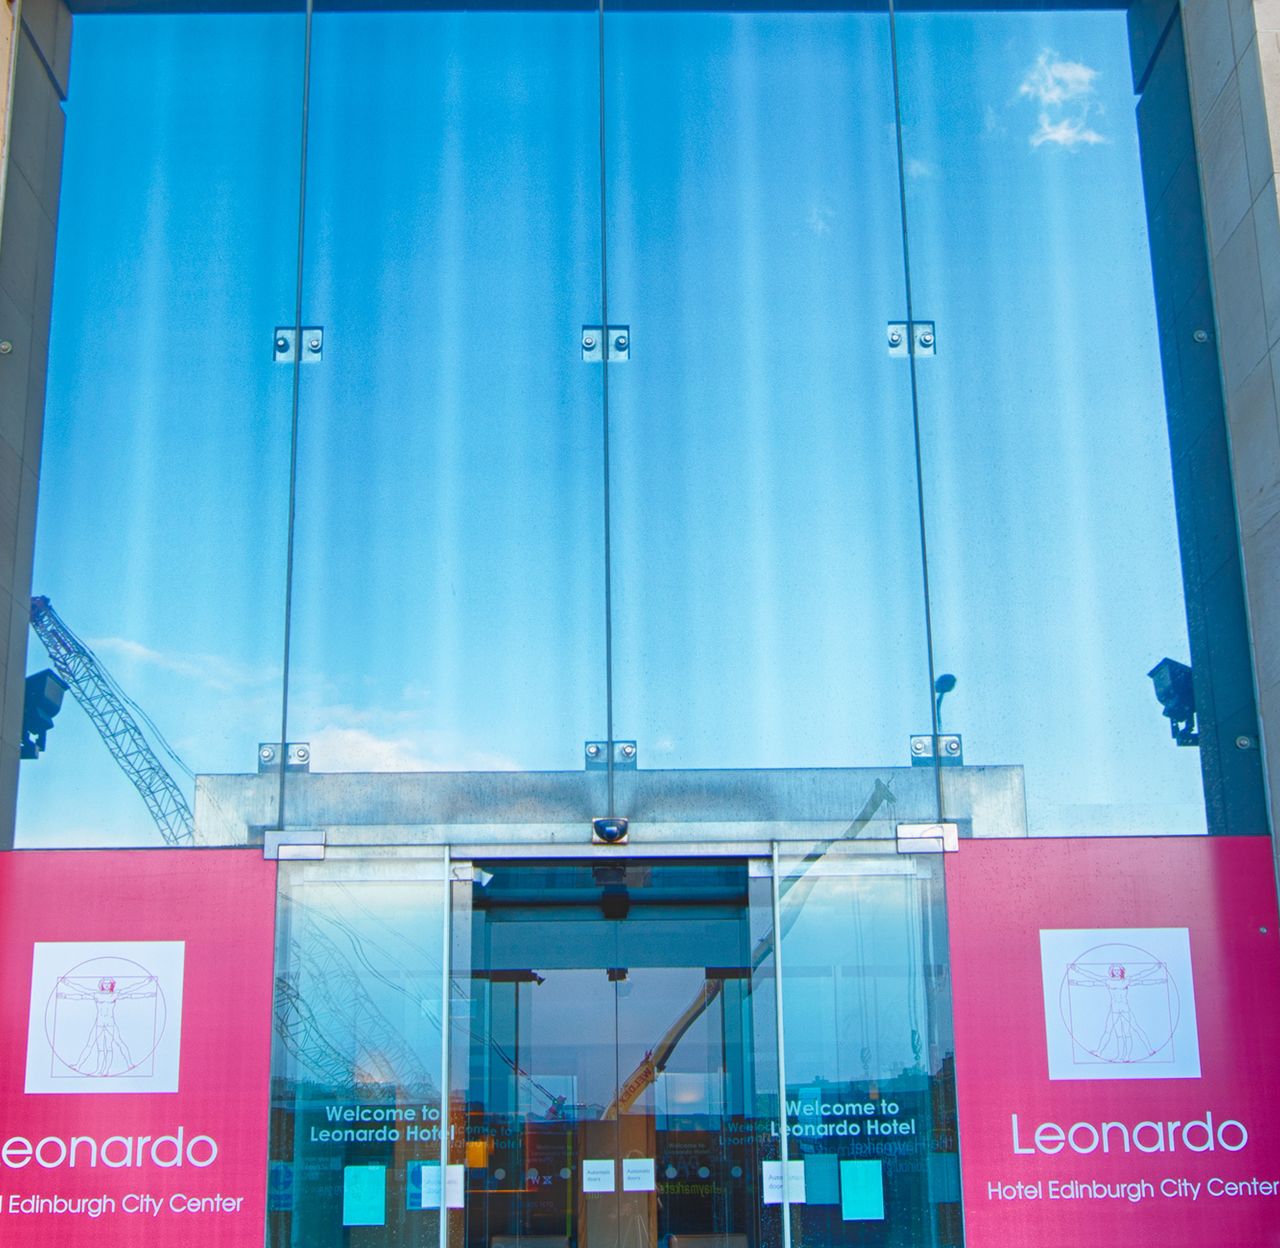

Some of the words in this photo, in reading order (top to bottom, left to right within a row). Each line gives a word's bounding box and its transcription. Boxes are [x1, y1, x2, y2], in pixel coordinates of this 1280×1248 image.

[325, 1106, 416, 1122] Welcome
[422, 1105, 440, 1122] to
[786, 1099, 875, 1116] Welcome
[880, 1099, 899, 1115] to
[310, 1125, 400, 1142] Leonardo
[406, 1125, 455, 1142] Hotel
[770, 1119, 860, 1137] Leonardo
[866, 1119, 916, 1135] Hotel
[1011, 1111, 1248, 1155] Leonardo
[987, 1180, 1043, 1200] Hotel
[1048, 1179, 1154, 1203] Edinburgh
[1160, 1178, 1201, 1201] City
[1207, 1177, 1280, 1197] Center
[8, 1194, 116, 1218] Edinburgh
[121, 1193, 164, 1217] City
[169, 1193, 244, 1213] Center
